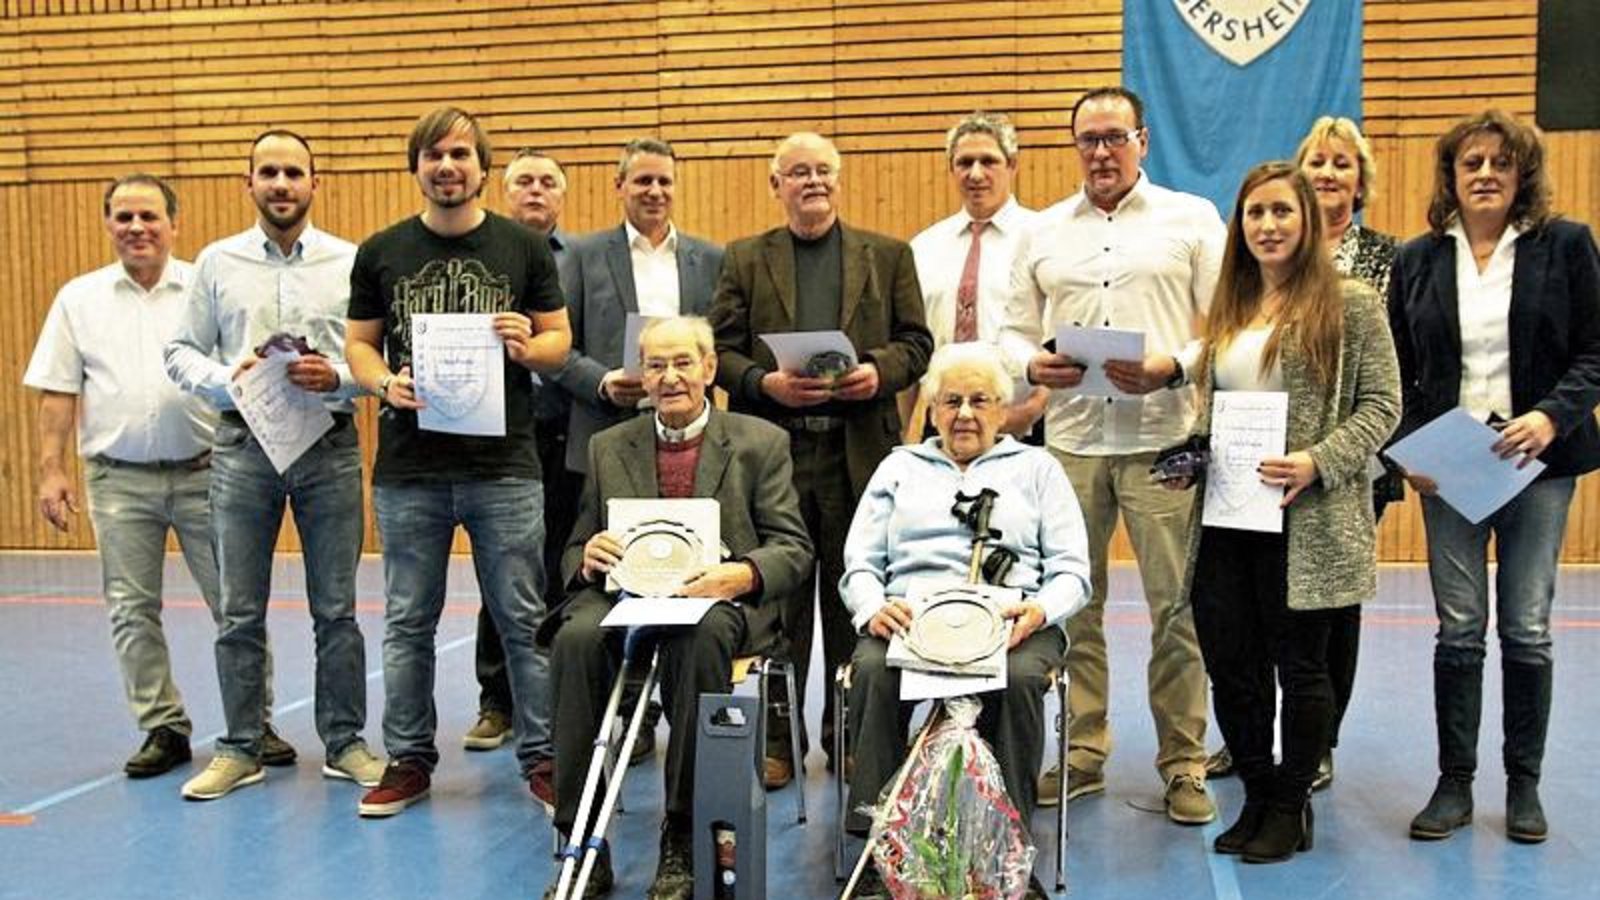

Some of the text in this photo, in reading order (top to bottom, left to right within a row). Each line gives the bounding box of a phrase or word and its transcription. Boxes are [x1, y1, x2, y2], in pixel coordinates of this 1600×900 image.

[1181, 0, 1302, 41] ERSHEI
[391, 273, 514, 320] Hard Rock
